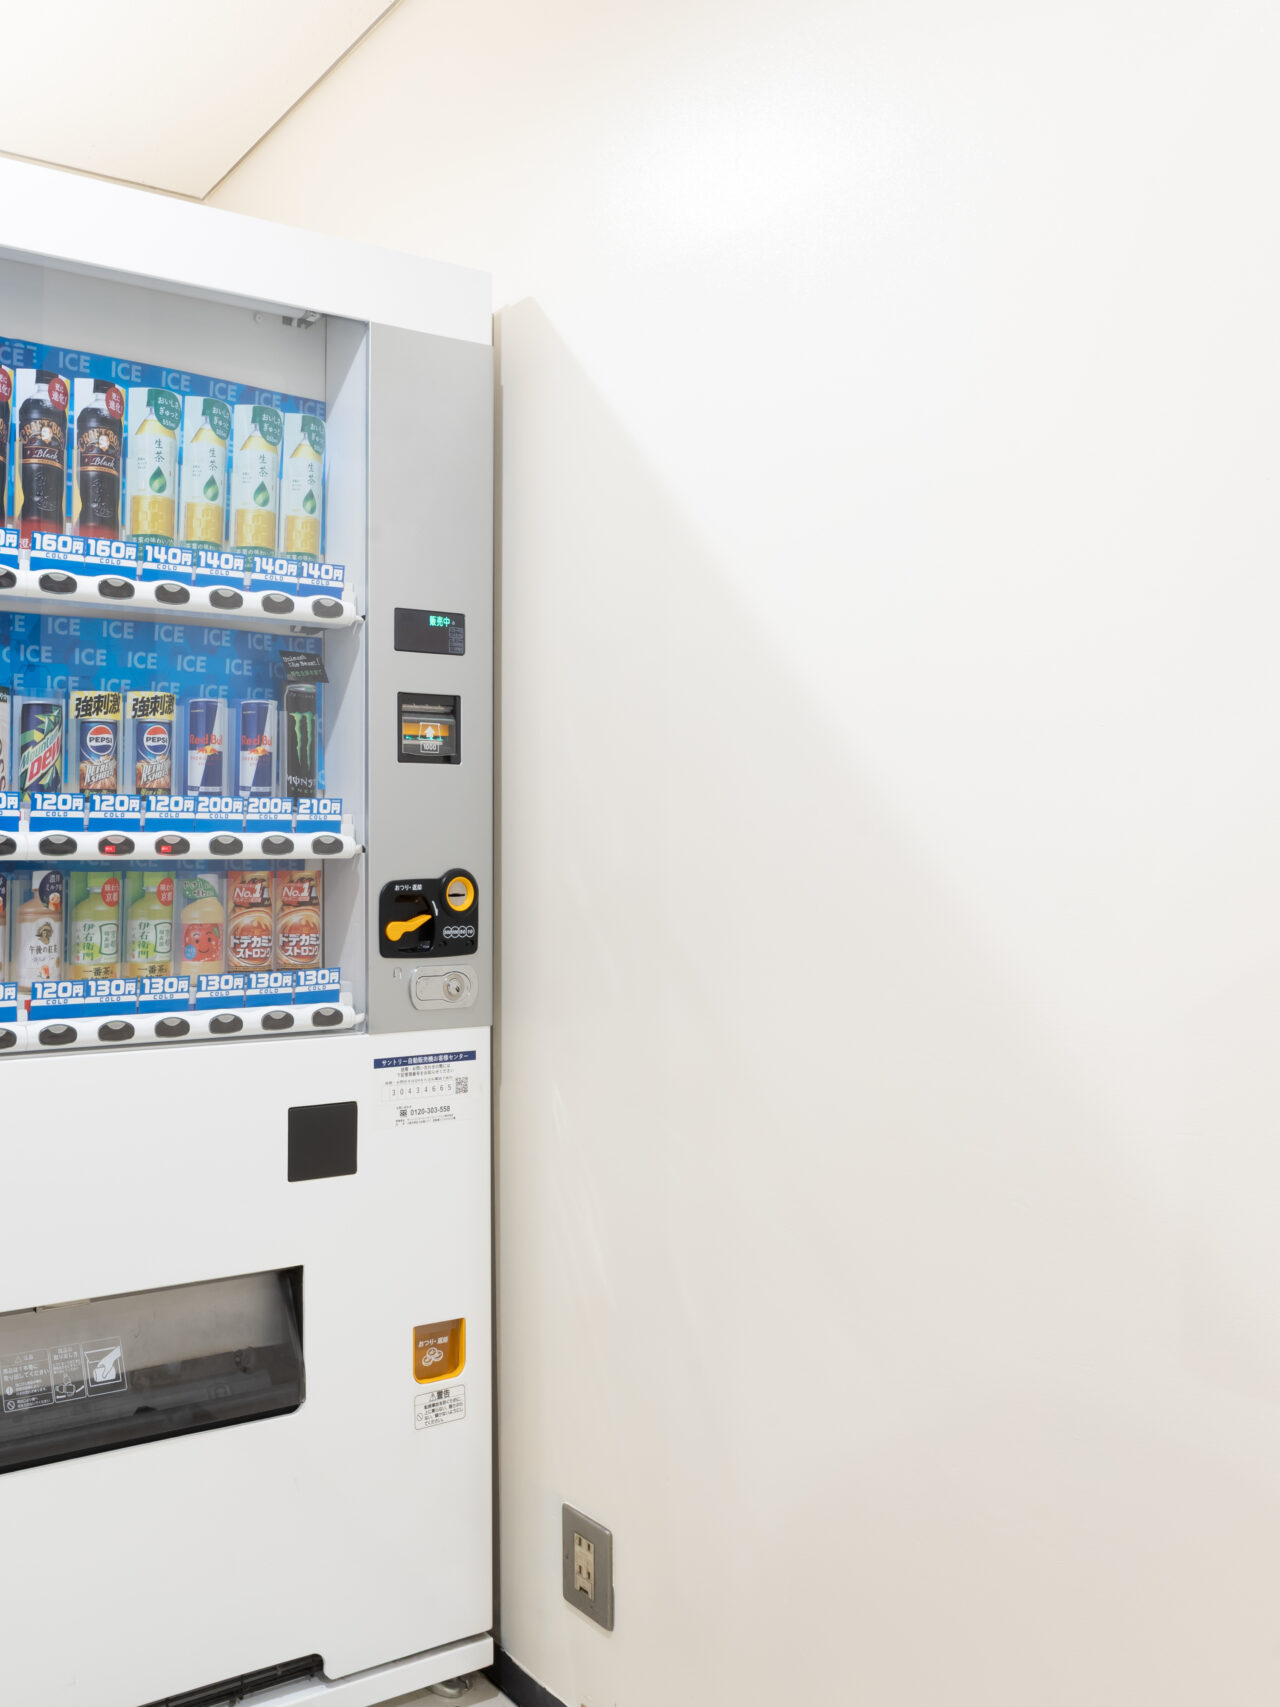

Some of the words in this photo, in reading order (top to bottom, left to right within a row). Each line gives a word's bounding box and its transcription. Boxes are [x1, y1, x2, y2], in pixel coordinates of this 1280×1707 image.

[59, 351, 90, 373] ICE
[111, 361, 142, 383] ICE
[162, 370, 191, 393] ICE
[32, 449, 59, 462] Black
[90, 456, 116, 469] Black
[33, 533, 84, 554] 160円
[87, 539, 137, 560] 160円
[145, 545, 192, 566] 140円
[199, 551, 244, 571] 140円
[254, 556, 297, 576] 140円
[301, 562, 343, 581] 140円
[429, 615, 451, 627] 販売中
[75, 648, 107, 666] ICE
[127, 651, 158, 669] ICE
[75, 693, 120, 719] 強刺激
[132, 693, 175, 719] 強刺激
[89, 736, 113, 745] PEPSI
[145, 736, 168, 745] PEPSI
[189, 733, 209, 745] Red
[241, 734, 261, 746] Red
[34, 794, 84, 812] 120円
[92, 795, 140, 812] 120円
[148, 796, 194, 812] 120円
[197, 797, 243, 813] 200円
[248, 798, 292, 813] 200円
[299, 798, 341, 814] 210円
[234, 883, 262, 899] No.1
[282, 882, 310, 897] No.1
[142, 977, 189, 994] 130円
[199, 975, 244, 991] 130円
[249, 972, 292, 988] 130円
[298, 969, 340, 986] 130円
[34, 981, 84, 999] 120円
[88, 980, 136, 997] 130円
[381, 1053, 469, 1067] サントリー自動販売機お客様センター
[410, 1105, 450, 1116] 0120-303-558
[437, 1388, 450, 1400] 警告
